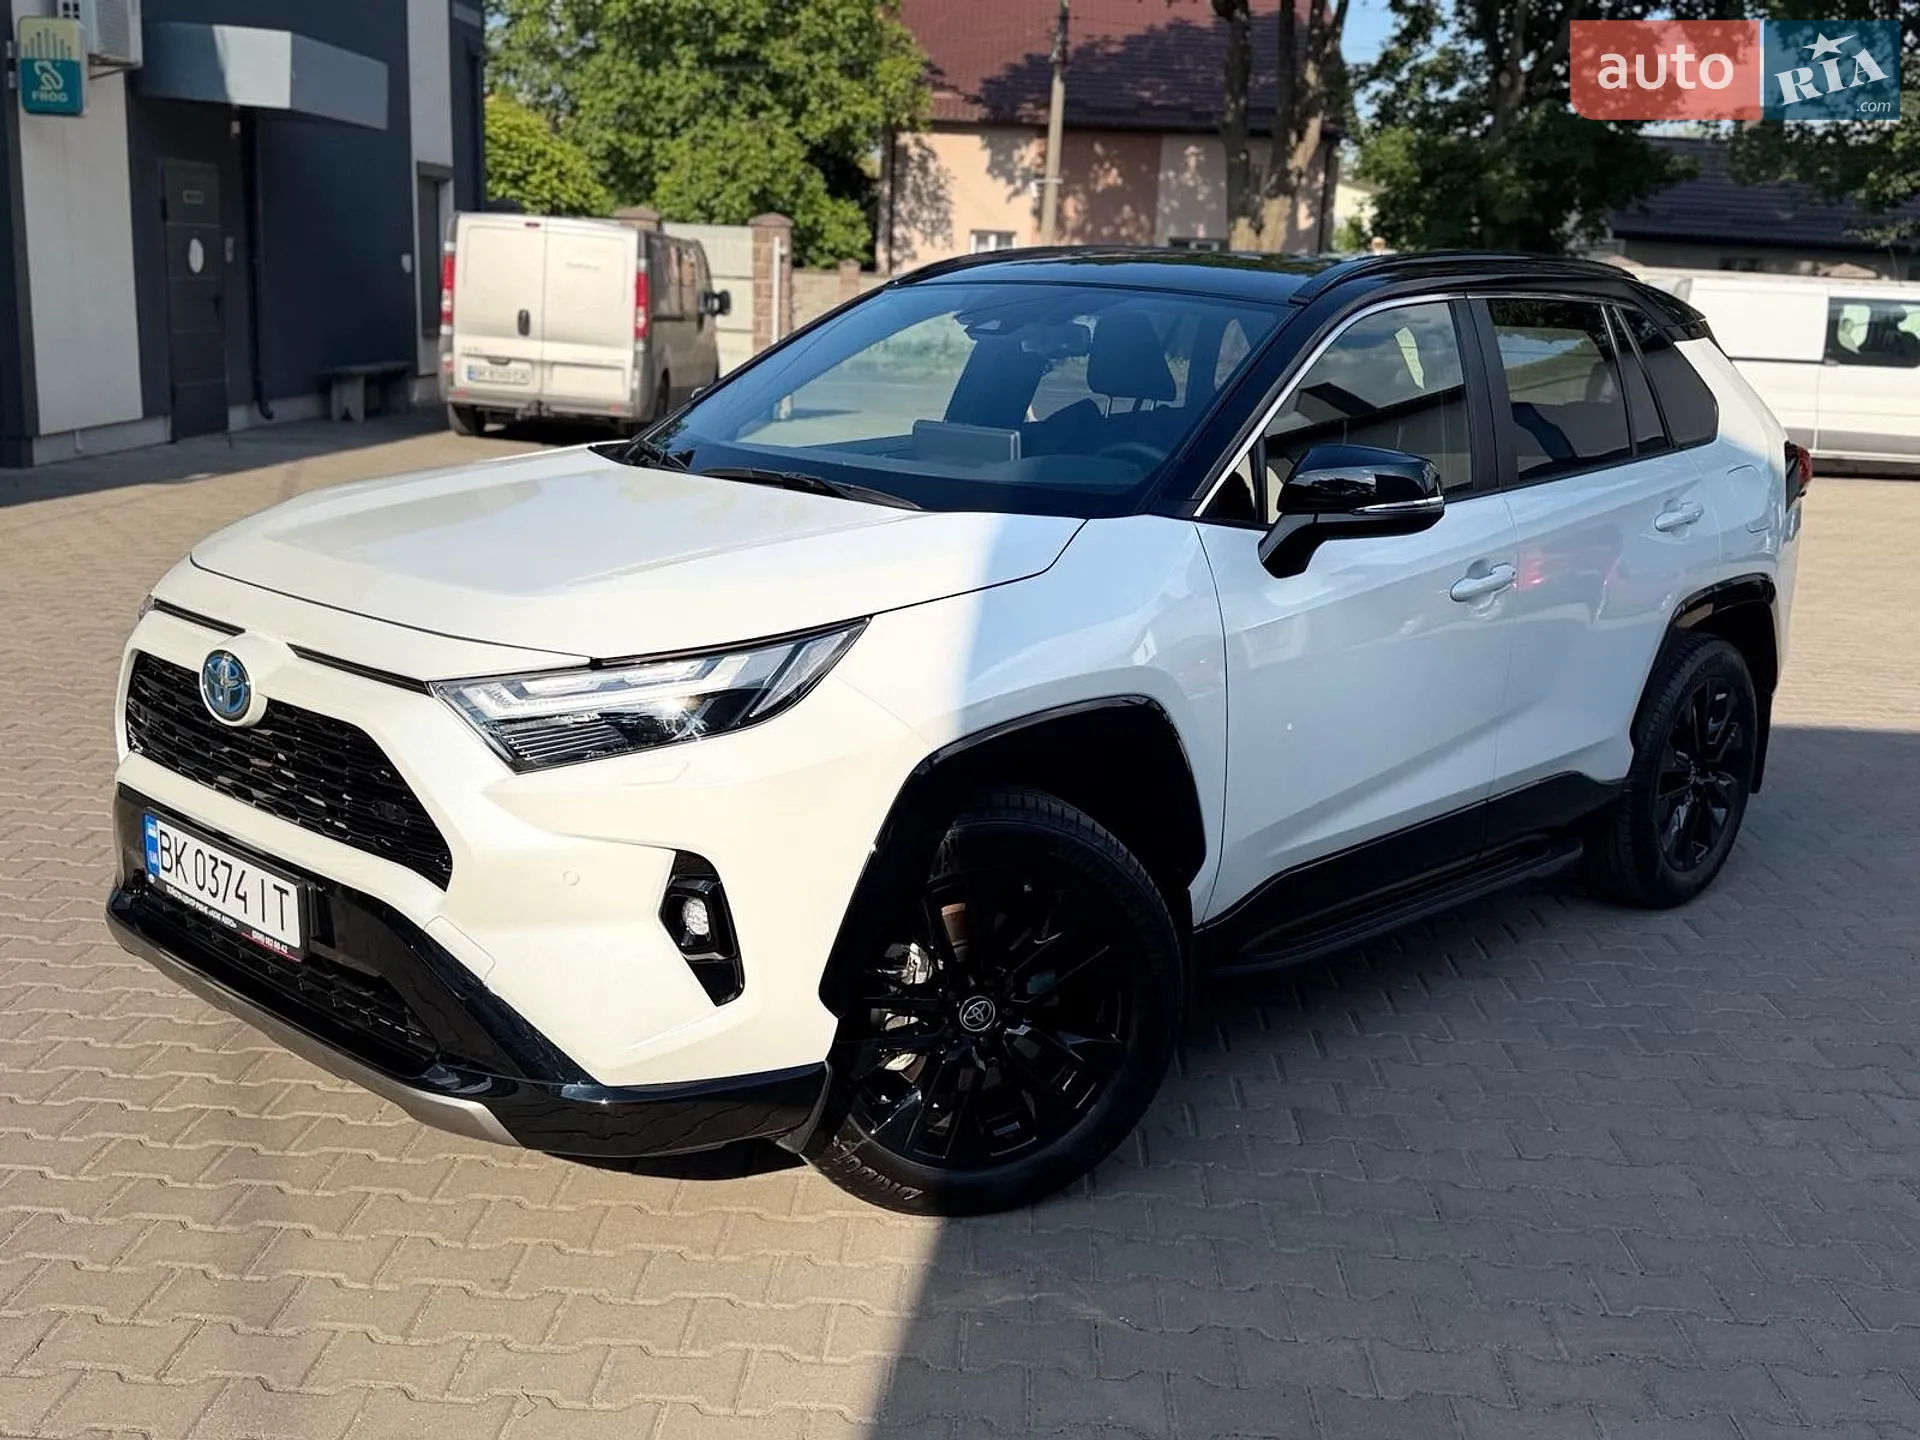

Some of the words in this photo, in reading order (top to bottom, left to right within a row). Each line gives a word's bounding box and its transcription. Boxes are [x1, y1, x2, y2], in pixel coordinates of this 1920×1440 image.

[160, 829, 188, 884] BK
[194, 849, 247, 914] 0374
[261, 878, 289, 930] IT
